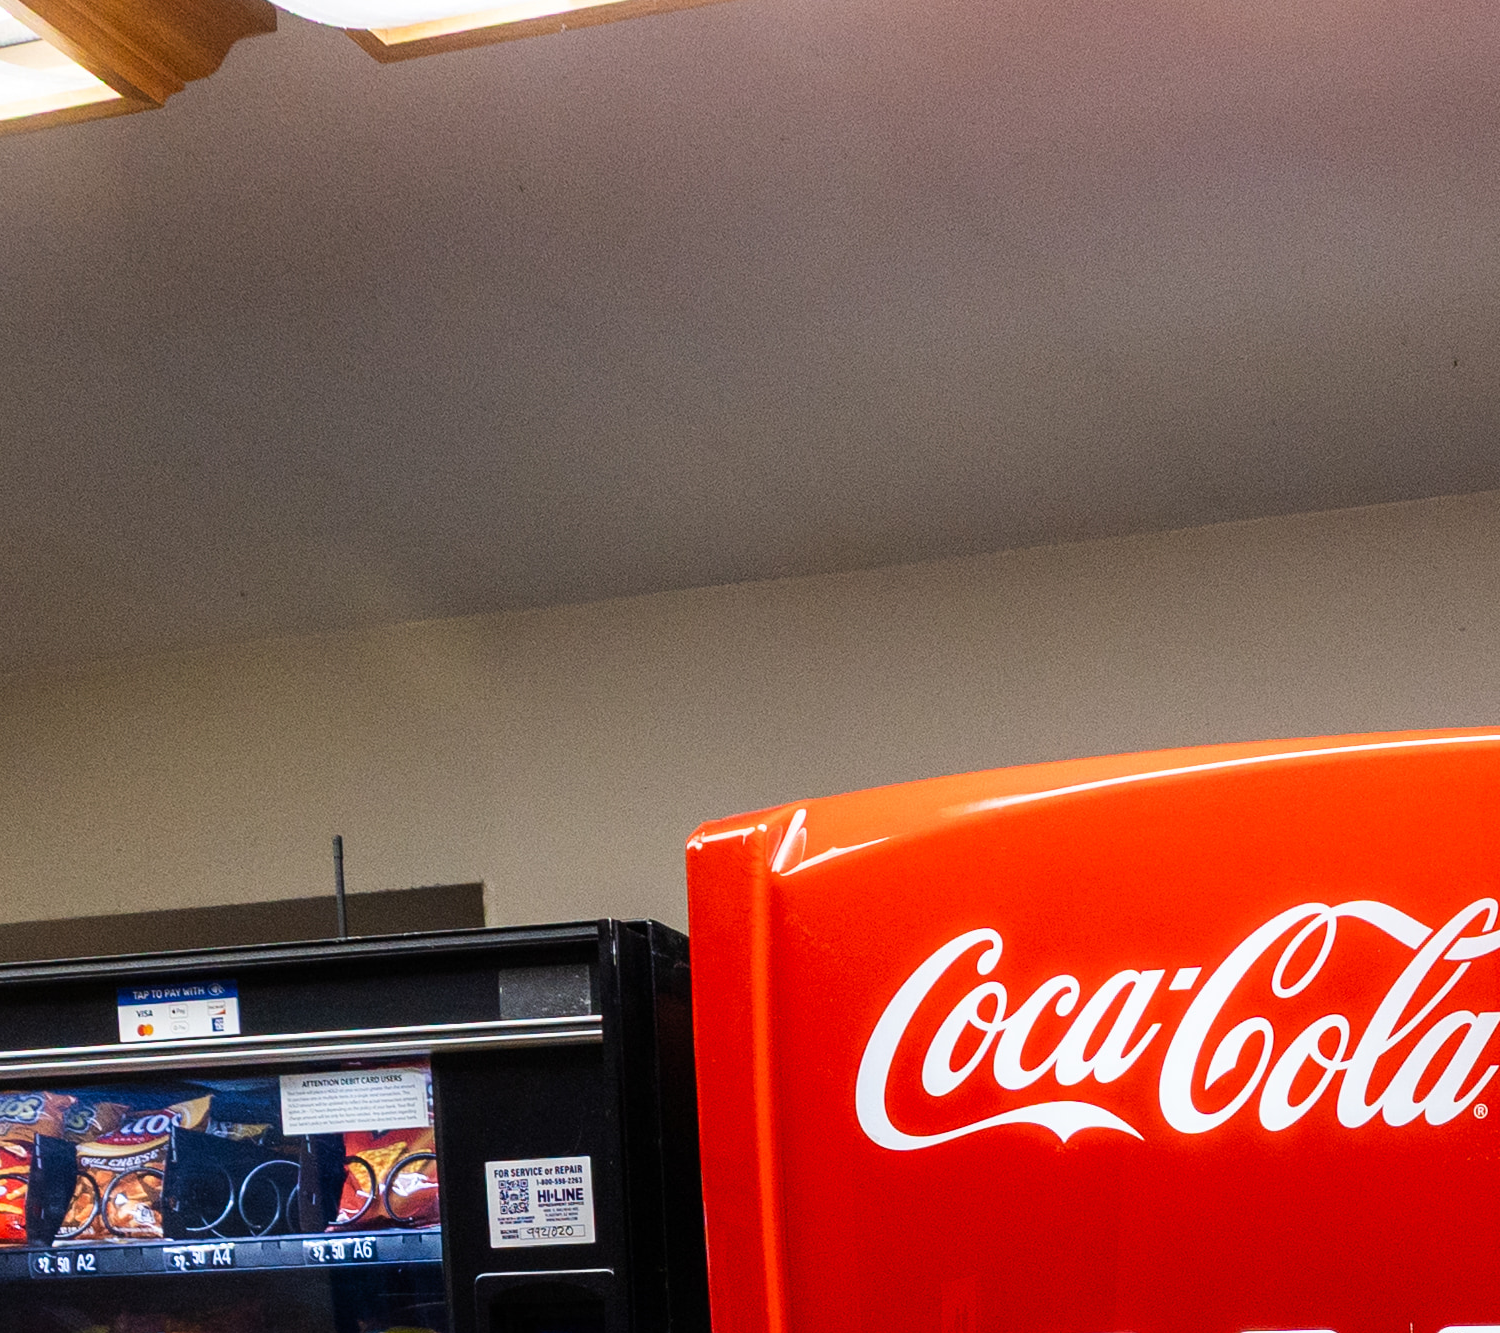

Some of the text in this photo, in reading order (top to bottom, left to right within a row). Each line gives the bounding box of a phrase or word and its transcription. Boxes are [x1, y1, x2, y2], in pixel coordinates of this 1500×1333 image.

[132, 987, 205, 1000] TAP TO PAY WITH
[136, 1009, 153, 1018] VISA
[302, 1075, 402, 1088] ATTENTION DEBIT CARD USERS
[108, 1150, 160, 1167] CHEESE
[494, 1169, 509, 1178] FOR
[511, 1167, 542, 1177] SERVICE
[555, 1165, 582, 1174] REPAIR
[212, 1247, 231, 1265] A4
[353, 1240, 373, 1258] A6
[77, 1253, 97, 1271] A2
